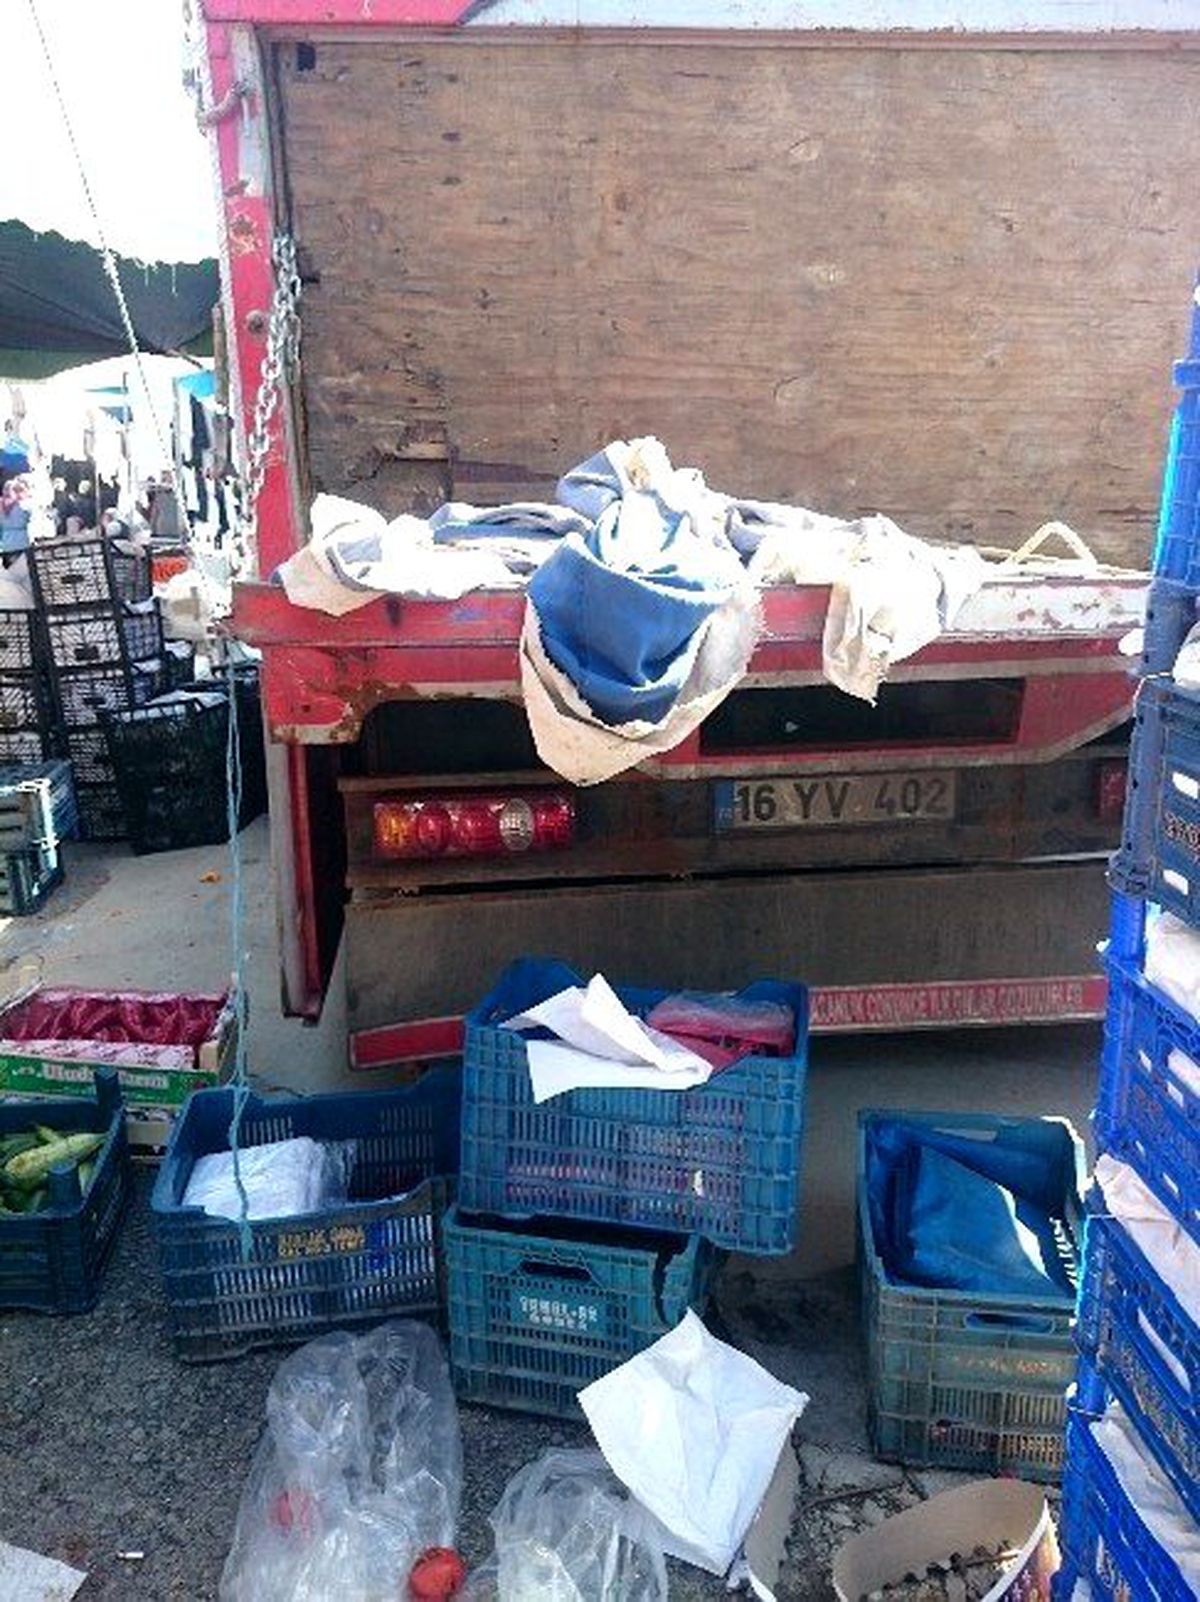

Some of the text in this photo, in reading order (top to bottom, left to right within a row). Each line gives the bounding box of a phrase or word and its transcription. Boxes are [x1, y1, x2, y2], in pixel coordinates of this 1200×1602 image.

[738, 778, 948, 821] 16 YV 402
